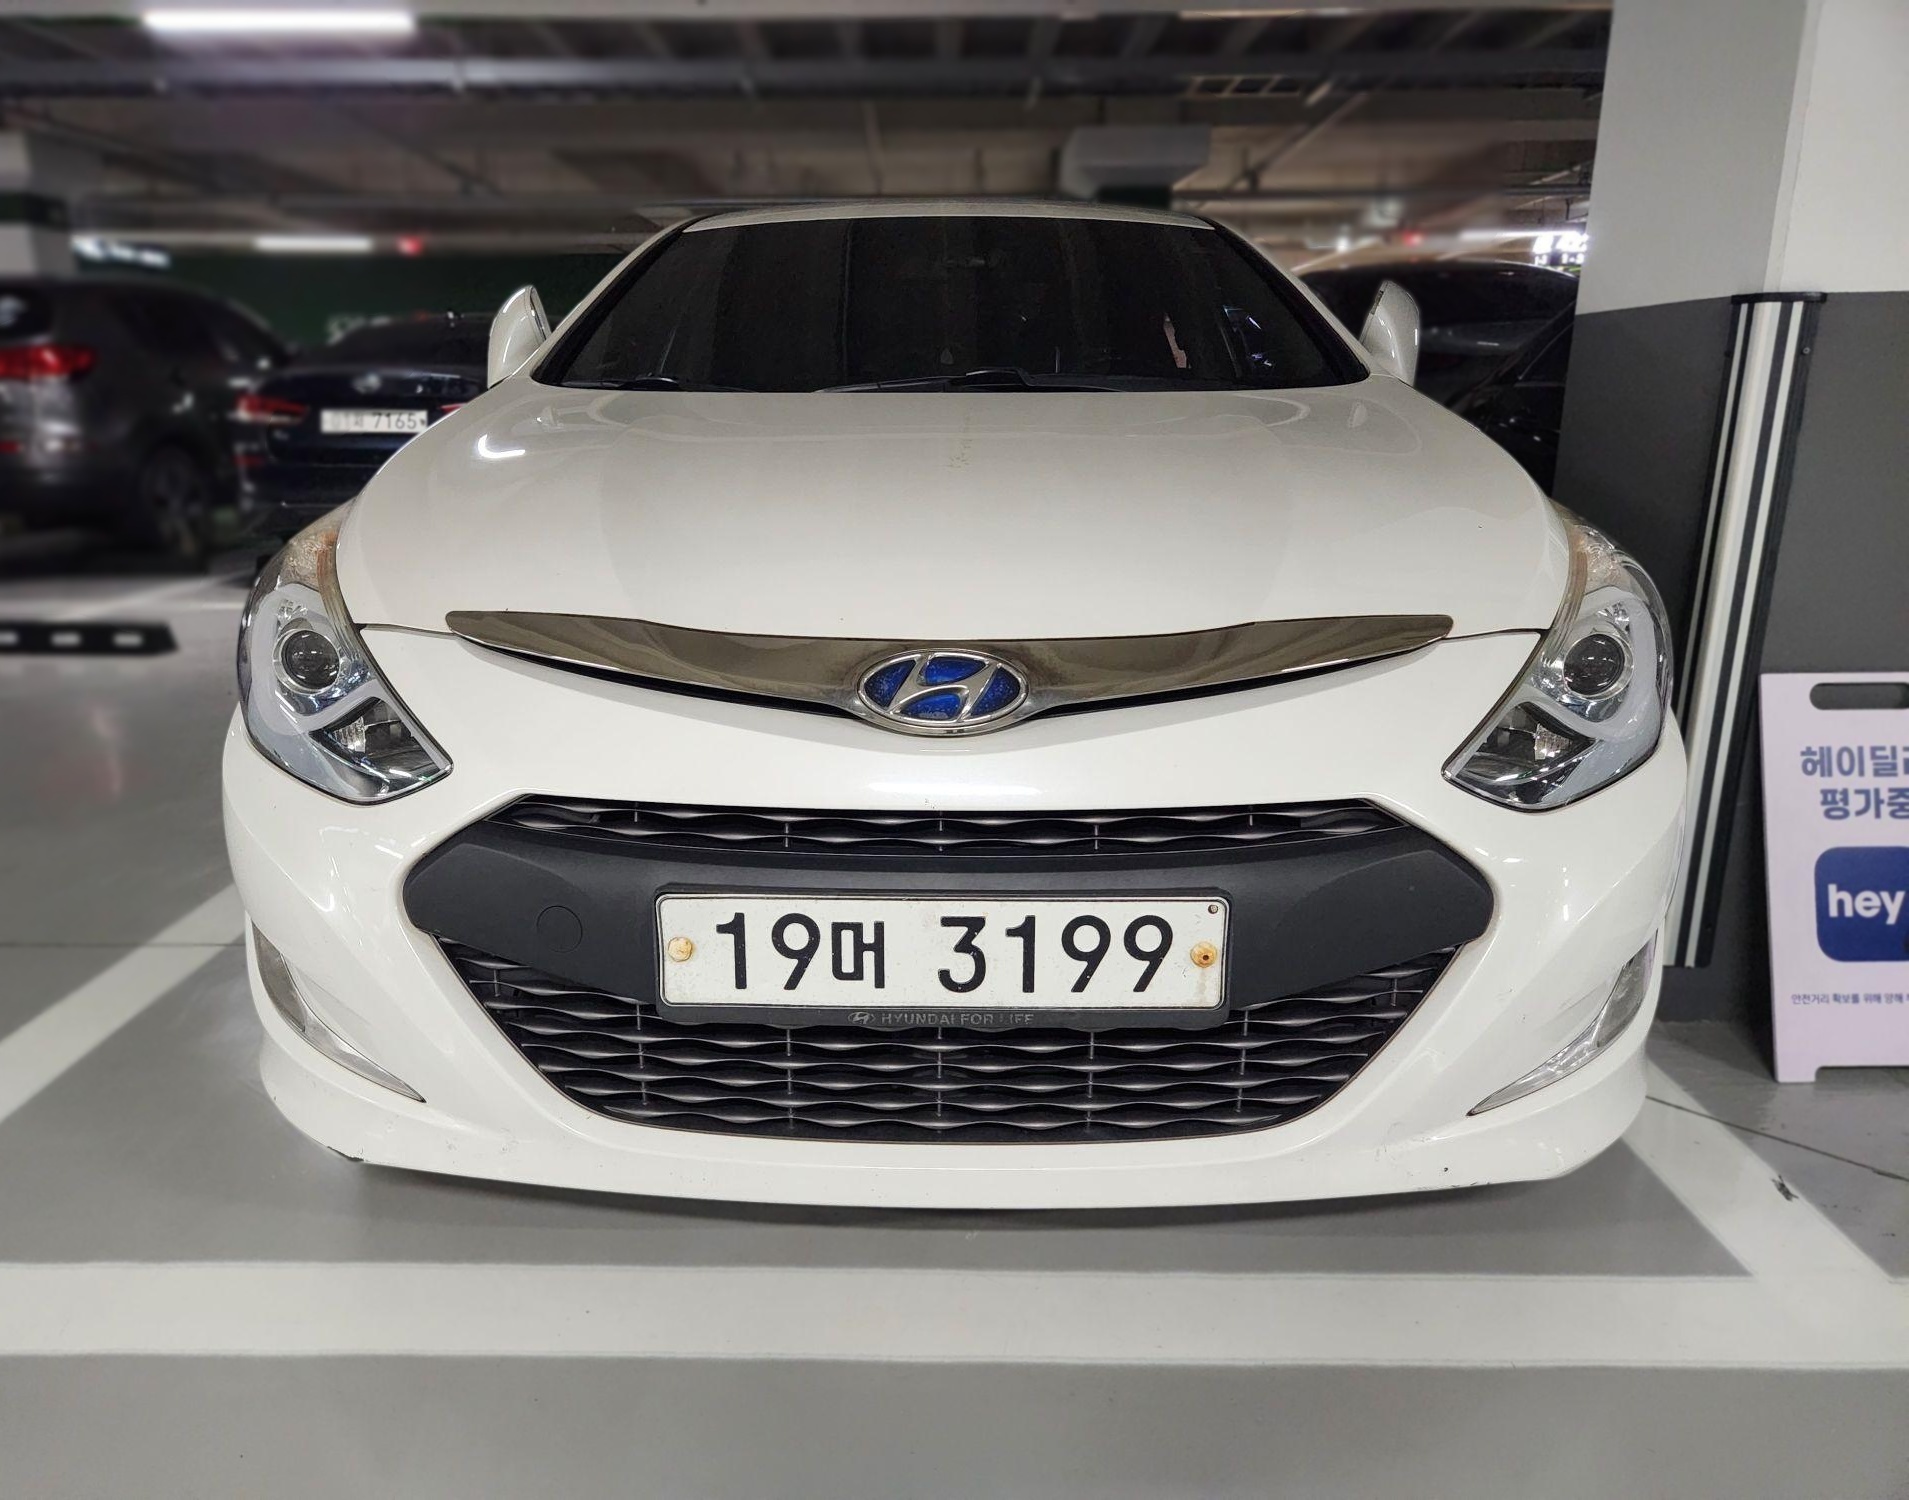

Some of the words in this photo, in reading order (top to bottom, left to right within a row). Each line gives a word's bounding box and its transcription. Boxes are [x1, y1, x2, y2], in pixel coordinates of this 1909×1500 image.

[372, 411, 418, 430] 7165
[1827, 883, 1906, 925] hey
[716, 912, 885, 991] 19머
[938, 914, 1174, 993] 3199
[1791, 993, 1830, 1005] 안전거리
[881, 1013, 955, 1025] HYUNDAI
[960, 1013, 994, 1025] FOR
